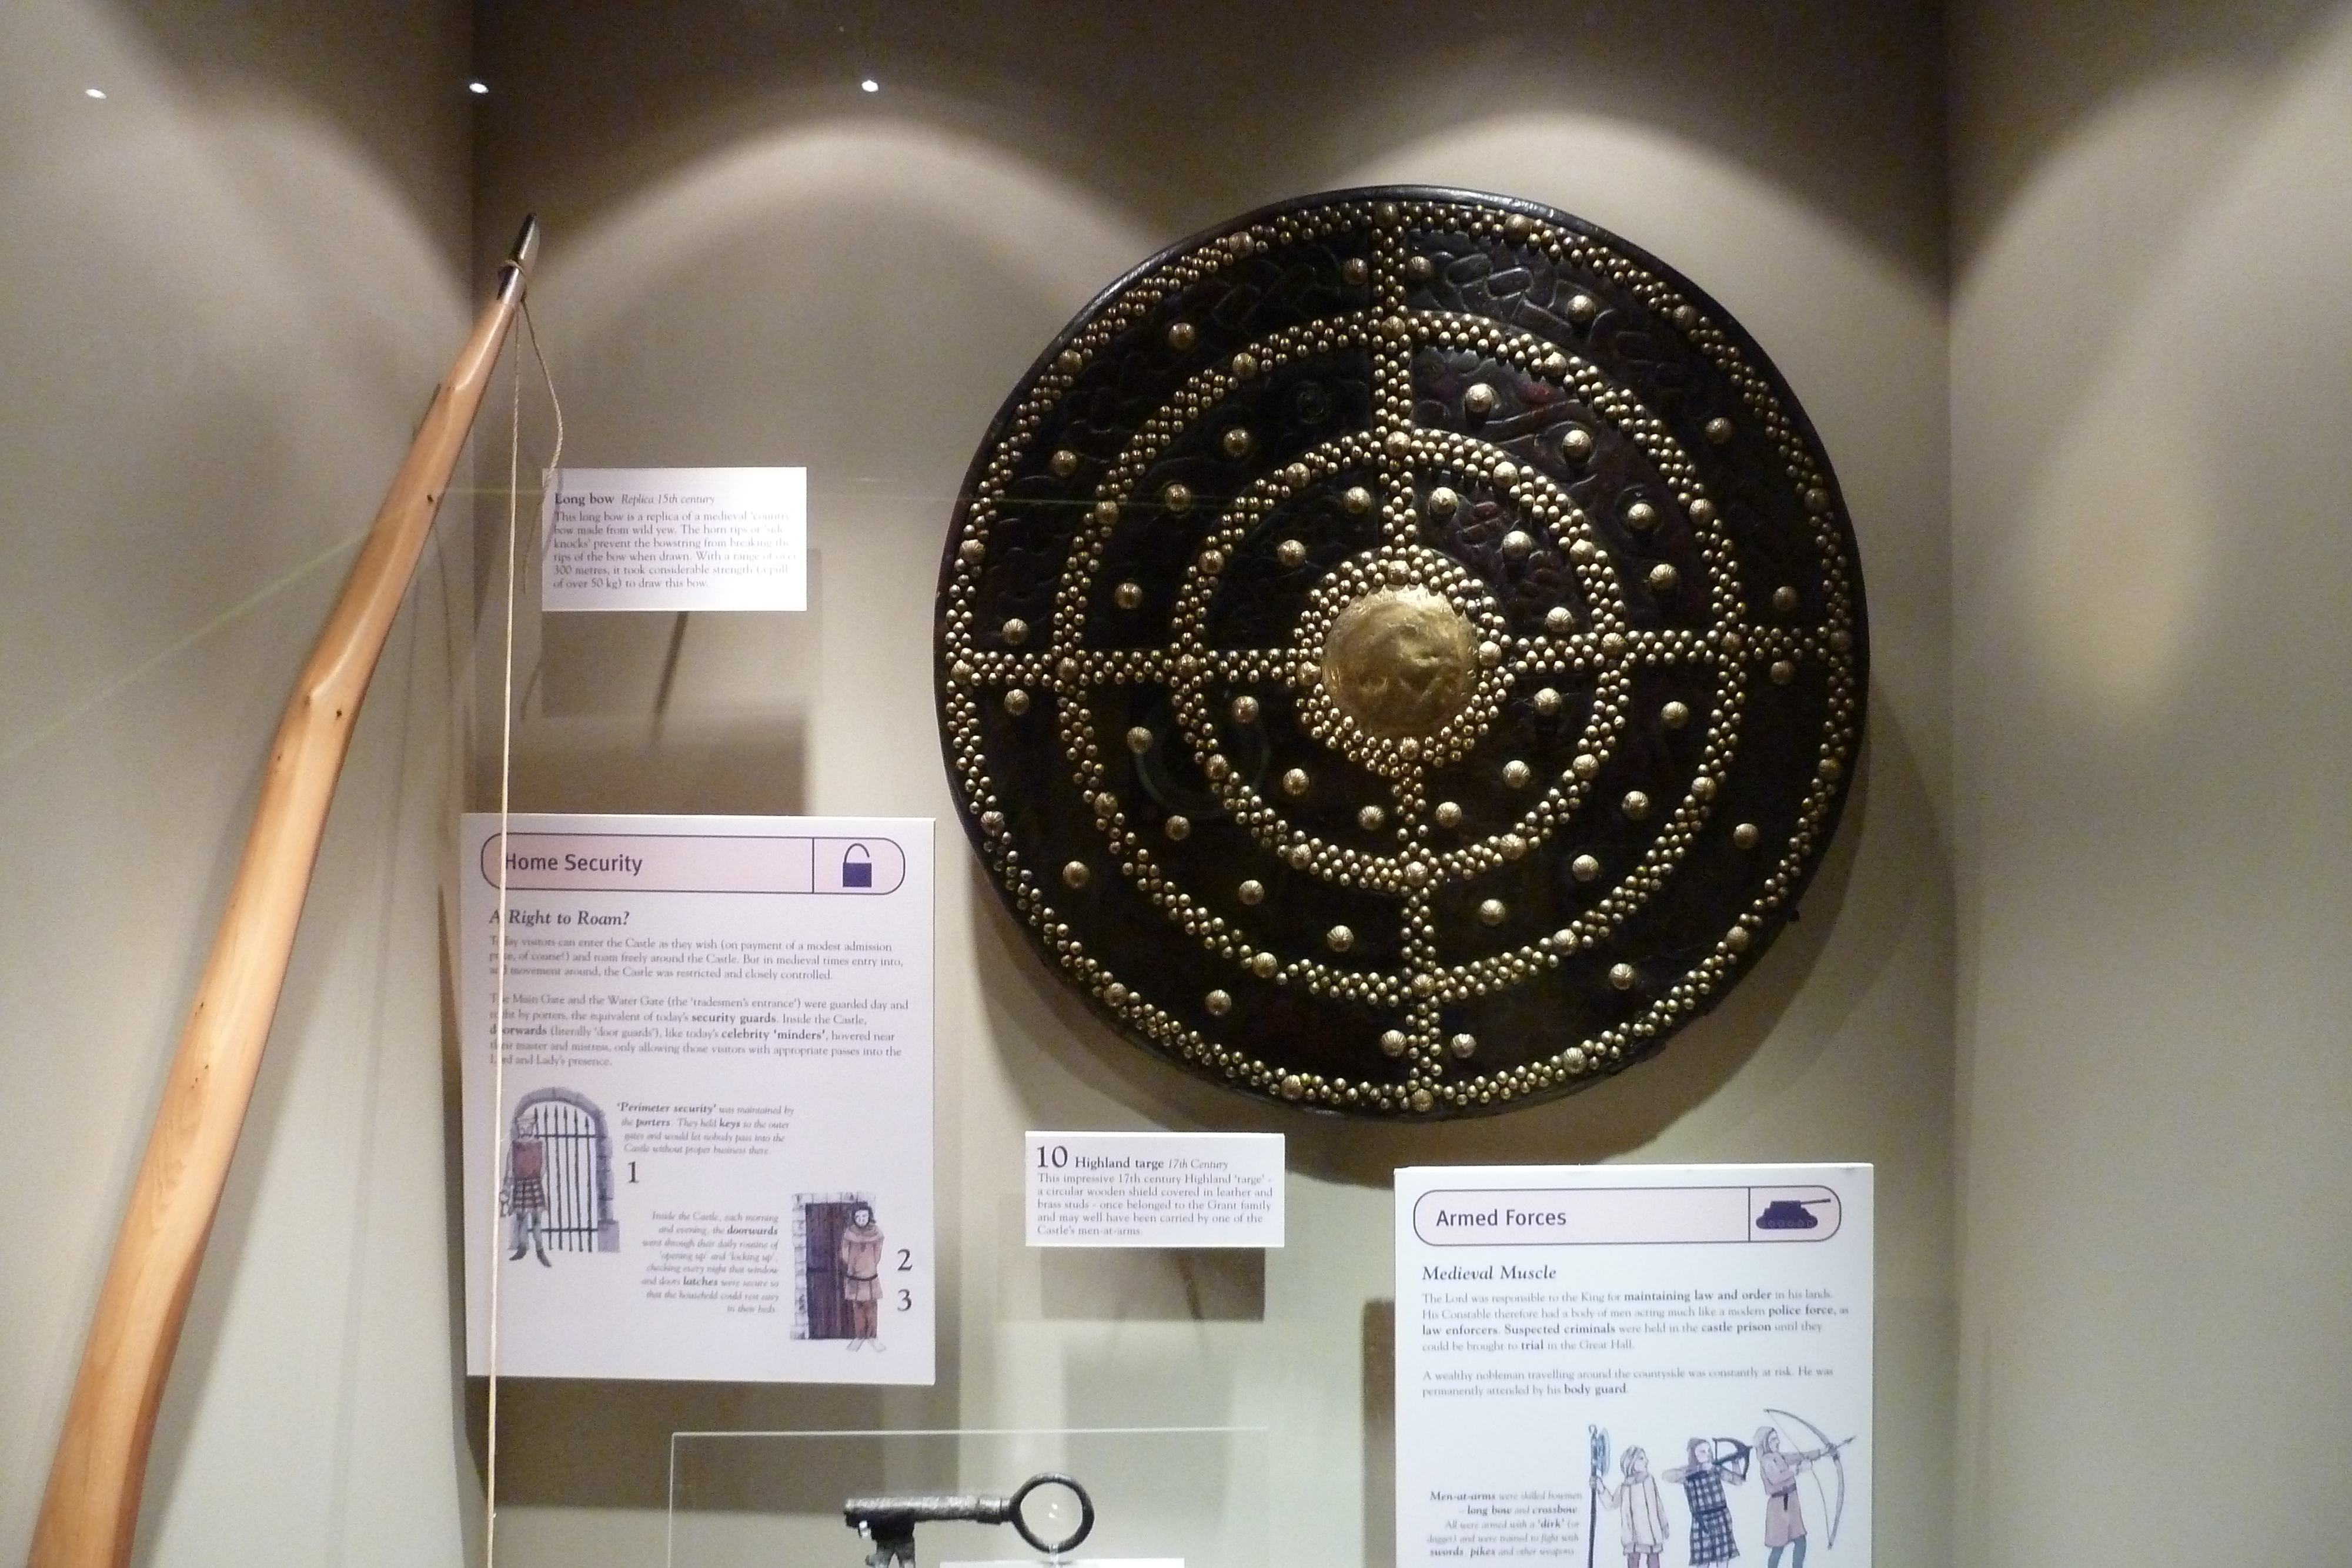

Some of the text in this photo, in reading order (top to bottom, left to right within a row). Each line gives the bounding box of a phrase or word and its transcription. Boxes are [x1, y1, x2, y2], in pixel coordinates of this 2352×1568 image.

[555, 493, 714, 506] Long bow Replica 15th century
[553, 510, 576, 521] This
[580, 510, 600, 524] long
[604, 510, 623, 521] bow
[627, 510, 634, 521] is
[647, 510, 679, 523] replica
[682, 510, 690, 521] of
[554, 524, 573, 534] bow
[577, 523, 603, 534] made
[633, 523, 653, 534] wild
[656, 526, 676, 536] yew.
[683, 523, 699, 534] The
[704, 523, 726, 533] horn
[554, 537, 590, 548] knocks'
[594, 539, 630, 550] prevent
[634, 536, 650, 547] the
[654, 536, 700, 550] bowstring
[730, 536, 771, 549] breaking
[554, 577, 563, 587] of
[592, 577, 603, 587] 50
[607, 577, 622, 590] kg)
[626, 578, 635, 587] to
[639, 577, 660, 587] draw
[666, 577, 683, 587] this
[687, 577, 709, 587] bow.
[506, 853, 643, 876] Home Security
[489, 909, 630, 927] A Right to Roam?
[696, 938, 717, 948] wish
[721, 938, 737, 951] (on
[741, 940, 781, 951] payment
[786, 939, 796, 950] of
[807, 940, 840, 950] modest
[844, 940, 891, 951] admission
[706, 952, 903, 968] Castle. But in medieval times entry into,
[692, 1011, 866, 1026] security guards. Inside the Castle,
[721, 1027, 769, 1039] celebrity
[774, 1028, 828, 1041] 'minders',
[832, 1029, 870, 1039] hovered
[617, 1102, 716, 1115] 'Perimeter security'
[1037, 1145, 1228, 1170] 10 Highland targe 17th Century
[628, 1161, 639, 1183] 1
[1038, 1173, 1264, 1186] This impressive 17th century Highland 'targe'
[1047, 1185, 1082, 1196] circular
[1088, 1185, 1125, 1196] wooden
[1129, 1185, 1157, 1196] shield
[1162, 1185, 1199, 1196] covered
[1204, 1185, 1212, 1196] in
[1217, 1185, 1250, 1196] leather
[1255, 1185, 1272, 1196] and
[1038, 1198, 1061, 1209] brass
[1065, 1199, 1088, 1209] studs
[1127, 1199, 1171, 1212] belonged
[1175, 1200, 1185, 1209] to
[1188, 1199, 1204, 1209] the
[1208, 1199, 1236, 1209] Grant
[1241, 1199, 1271, 1212] family
[1038, 1212, 1055, 1222] and
[1060, 1215, 1078, 1225] may
[1083, 1212, 1102, 1222] well
[1107, 1212, 1129, 1222] have
[1134, 1212, 1156, 1222] been
[1160, 1212, 1194, 1222] carried
[1198, 1212, 1208, 1225] by
[1234, 1212, 1244, 1222] of
[1247, 1212, 1262, 1222] the
[1436, 1208, 1566, 1226] Armed Forces
[1037, 1224, 1142, 1235] Castle's men-at-arms.
[897, 1249, 913, 1271] 2
[1422, 1265, 1557, 1281] Medieval Muscle
[897, 1289, 912, 1311] 3
[1423, 1293, 1441, 1303] The
[1446, 1292, 1467, 1303] Lord
[1492, 1292, 1545, 1305] responsible
[1549, 1293, 1558, 1302] to
[1562, 1291, 1577, 1302] the
[1582, 1291, 1604, 1304] King
[1608, 1290, 1619, 1301] for
[1625, 1290, 1690, 1303] maintaining
[1695, 1290, 1712, 1300] law
[1718, 1289, 1737, 1300] and
[1742, 1289, 1770, 1300] order
[1776, 1289, 1784, 1299] in
[1789, 1289, 1802, 1299] his
[1806, 1288, 1833, 1299] lands.
[1769, 1305, 1836, 1318] police force,
[1423, 1324, 1441, 1335] law
[1446, 1324, 1500, 1335] enforcers.
[1505, 1323, 1559, 1336] Suspected
[1564, 1323, 1615, 1333] criminals
[1645, 1322, 1665, 1332] held
[1669, 1322, 1679, 1332] in
[1682, 1322, 1698, 1332] the
[1702, 1321, 1732, 1332] castle
[1737, 1321, 1771, 1334] prison
[1775, 1320, 1798, 1331] until
[1801, 1320, 1822, 1333] they
[1522, 1339, 1544, 1350] trial
[1423, 1383, 1628, 1398] permanently attended by his body guard.
[1431, 1491, 1495, 1500] Men-at-arms
